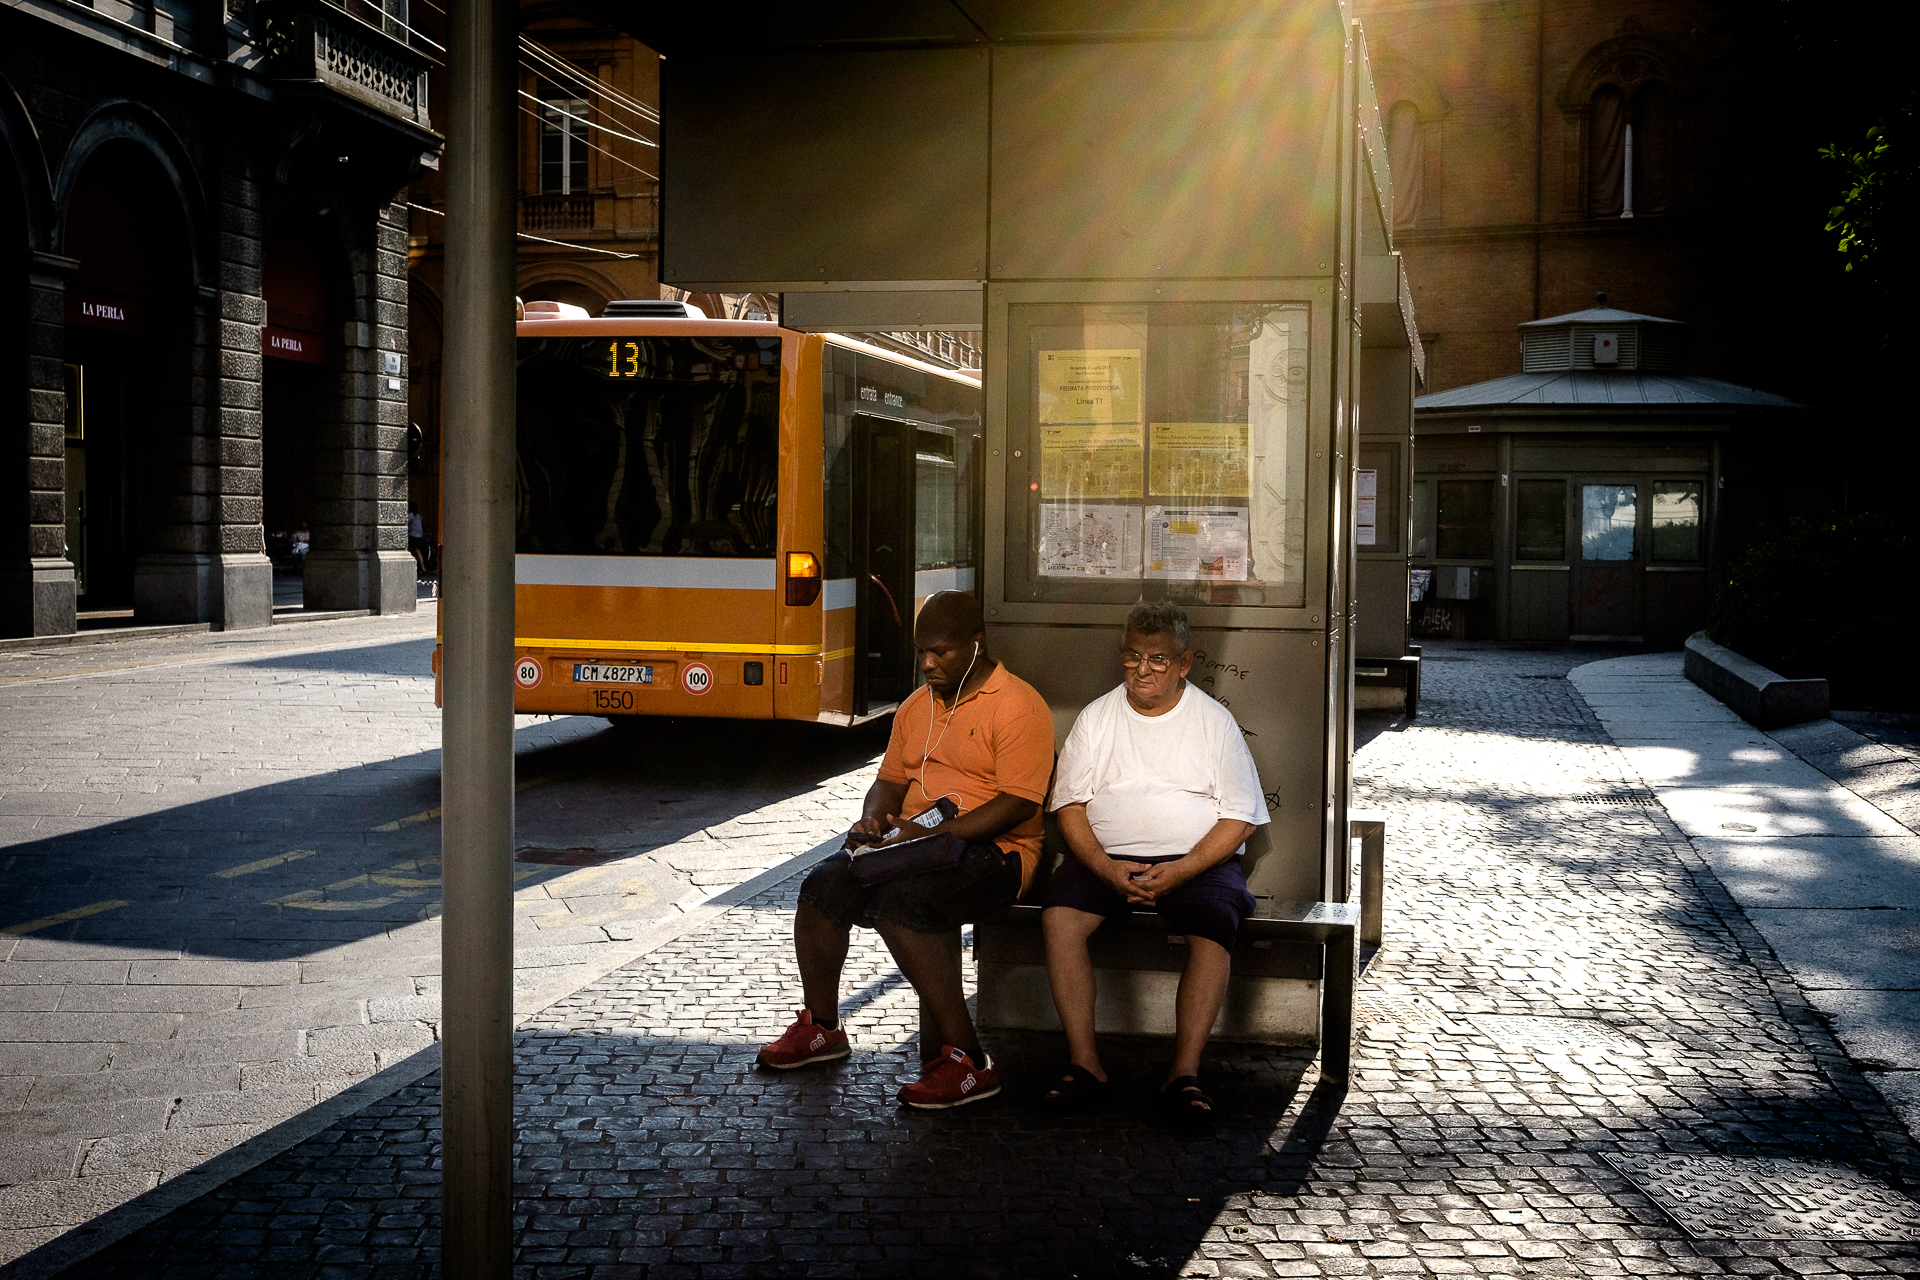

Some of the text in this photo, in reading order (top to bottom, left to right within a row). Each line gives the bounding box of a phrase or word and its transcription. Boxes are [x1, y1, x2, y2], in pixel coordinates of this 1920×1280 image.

[83, 302, 124, 320] LA PERLA
[271, 335, 302, 352] LA PERLA
[609, 342, 639, 377] 13
[861, 386, 903, 408] entrata entrance
[1076, 397, 1103, 405] Linea T1
[521, 666, 535, 679] 80
[582, 666, 599, 681] CM
[602, 667, 644, 682] 482PX
[689, 672, 708, 686] 100
[592, 689, 634, 710] 1550
